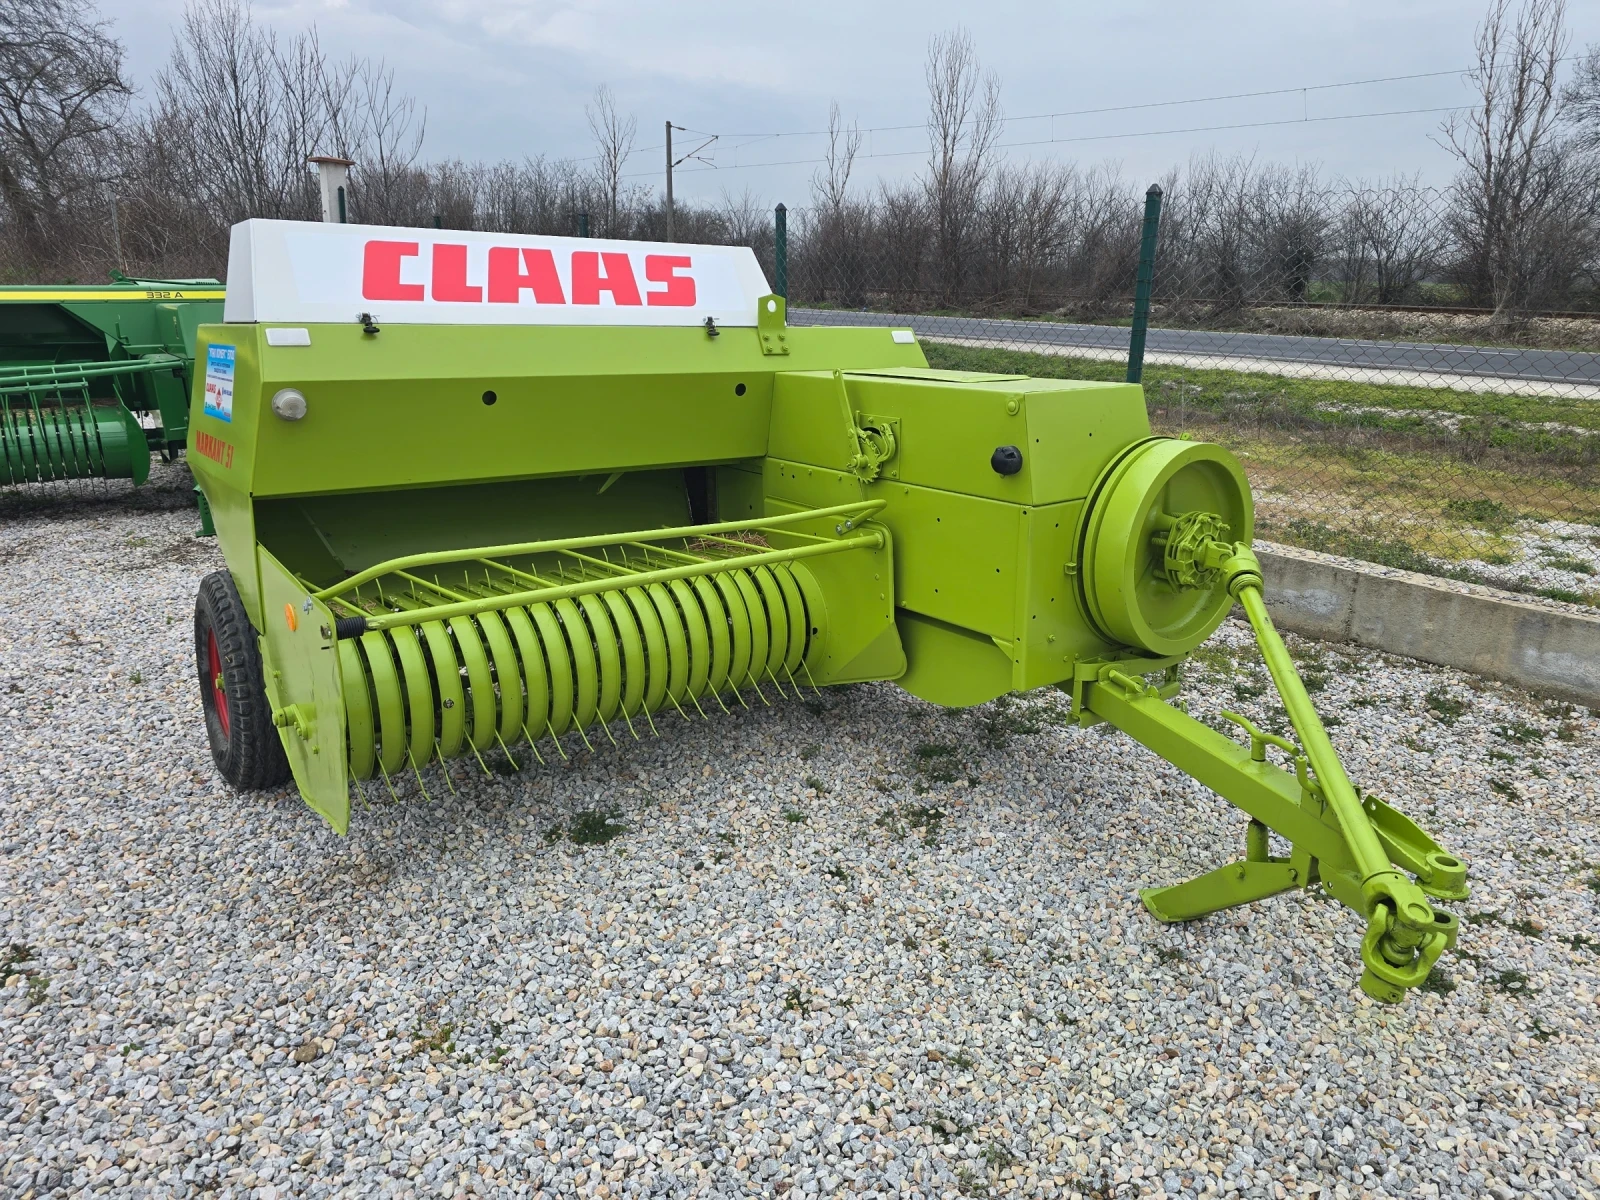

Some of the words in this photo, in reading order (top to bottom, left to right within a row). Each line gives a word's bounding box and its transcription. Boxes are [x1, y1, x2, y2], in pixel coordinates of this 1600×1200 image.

[362, 240, 697, 307] CLAAS
[146, 291, 171, 299] 332
[174, 291, 184, 299] A
[196, 429, 226, 465] MARKANT
[225, 444, 235, 470] 51
